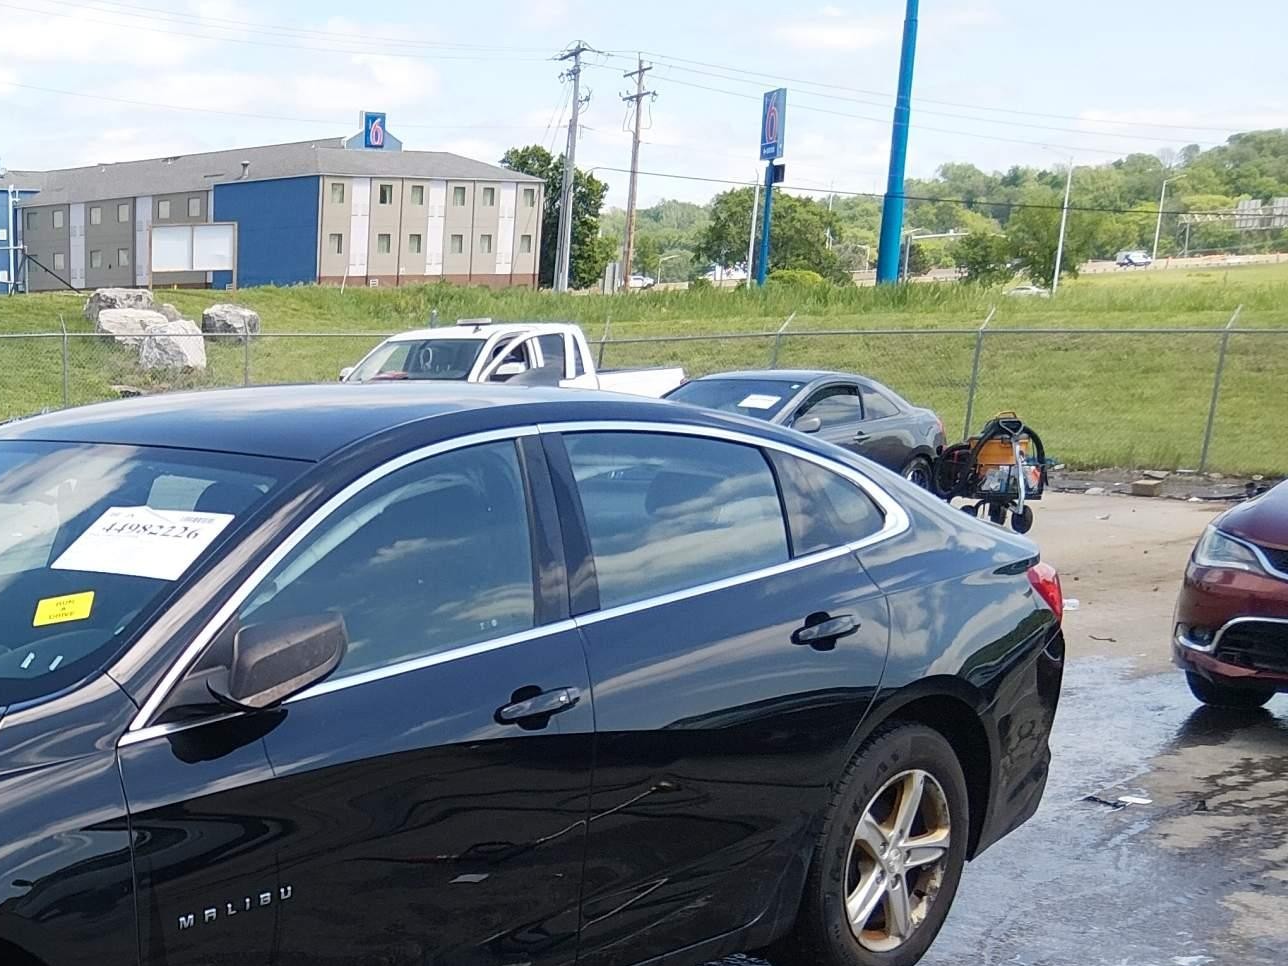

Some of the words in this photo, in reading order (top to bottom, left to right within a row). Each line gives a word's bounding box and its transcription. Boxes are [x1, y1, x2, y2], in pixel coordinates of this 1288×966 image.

[370, 118, 383, 145] 6
[766, 92, 778, 143] 6
[102, 522, 201, 539] 44982226
[178, 886, 292, 930] MALIBU
